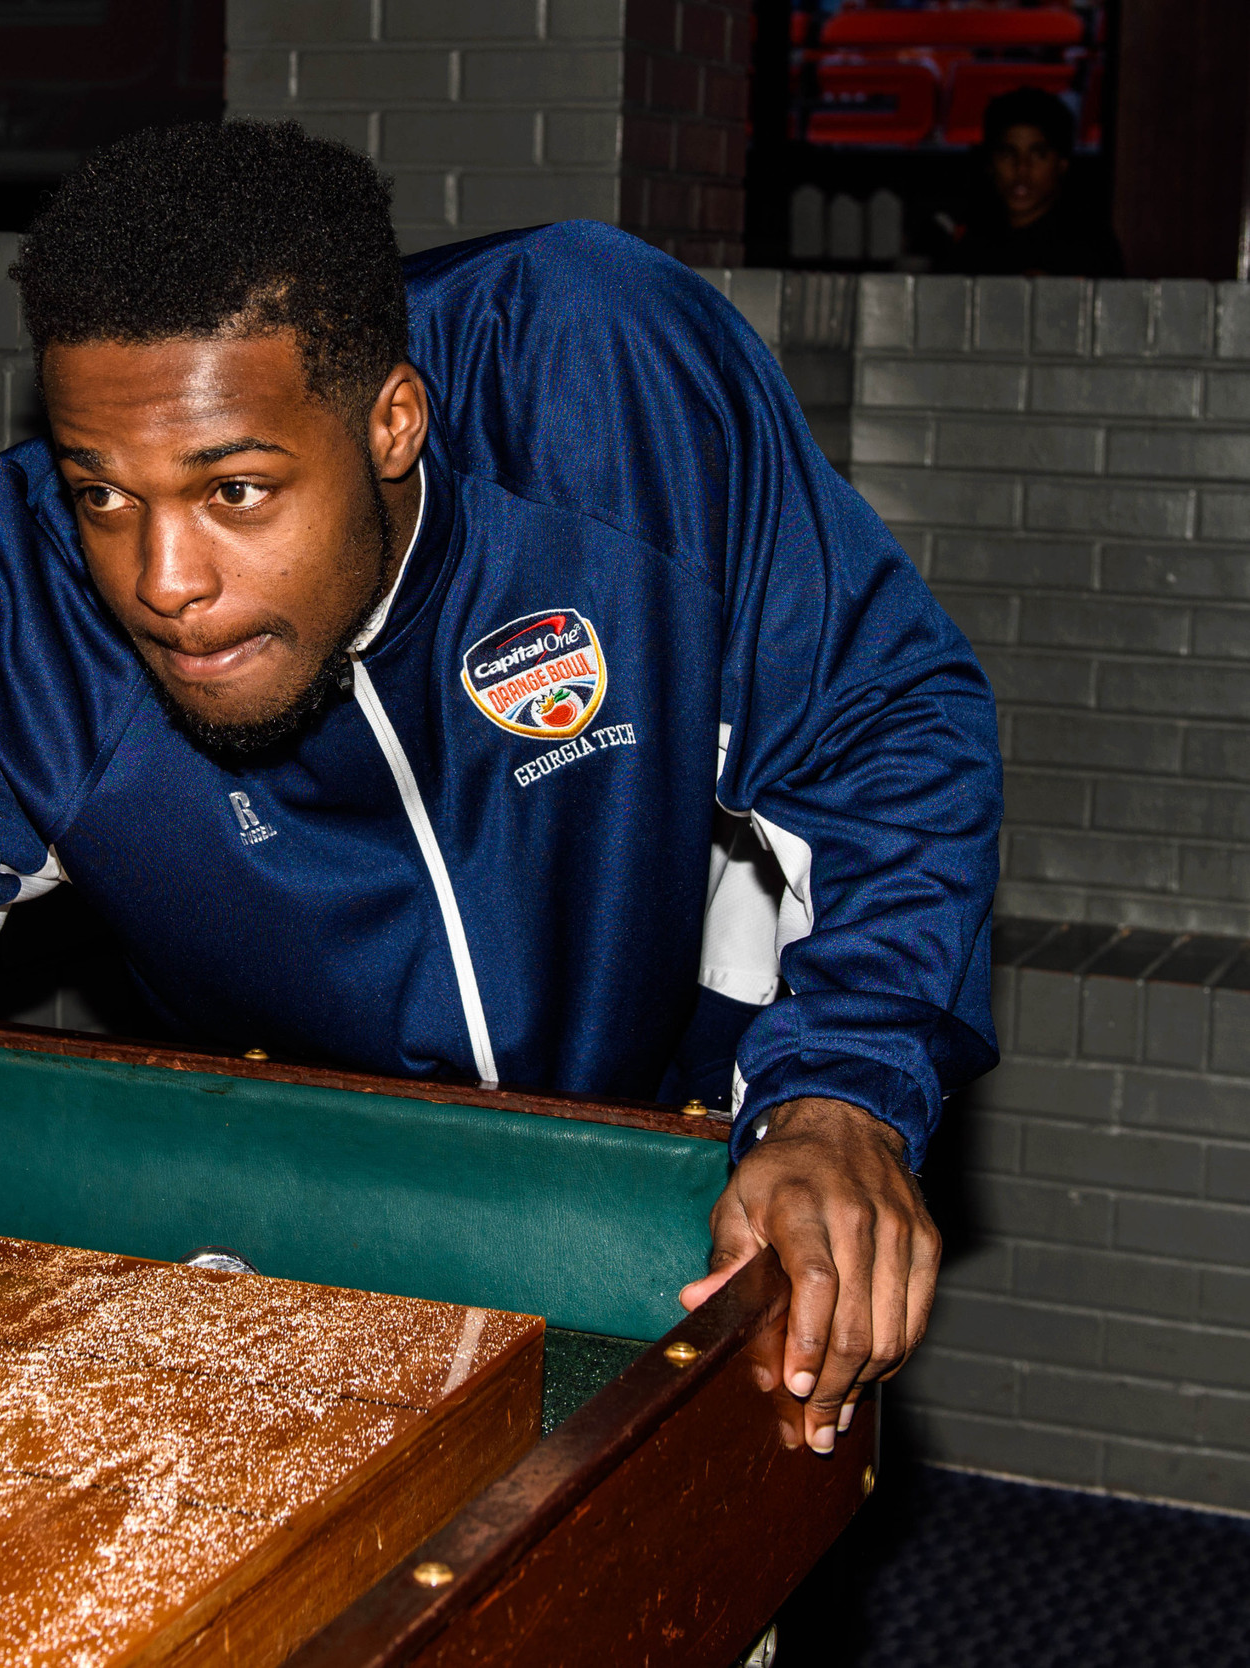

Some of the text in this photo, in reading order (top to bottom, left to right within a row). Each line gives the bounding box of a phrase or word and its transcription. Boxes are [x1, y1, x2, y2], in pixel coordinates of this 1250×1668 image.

[487, 652, 597, 714] ORANGE BOWL
[514, 723, 636, 787] GEORGIA TECH
